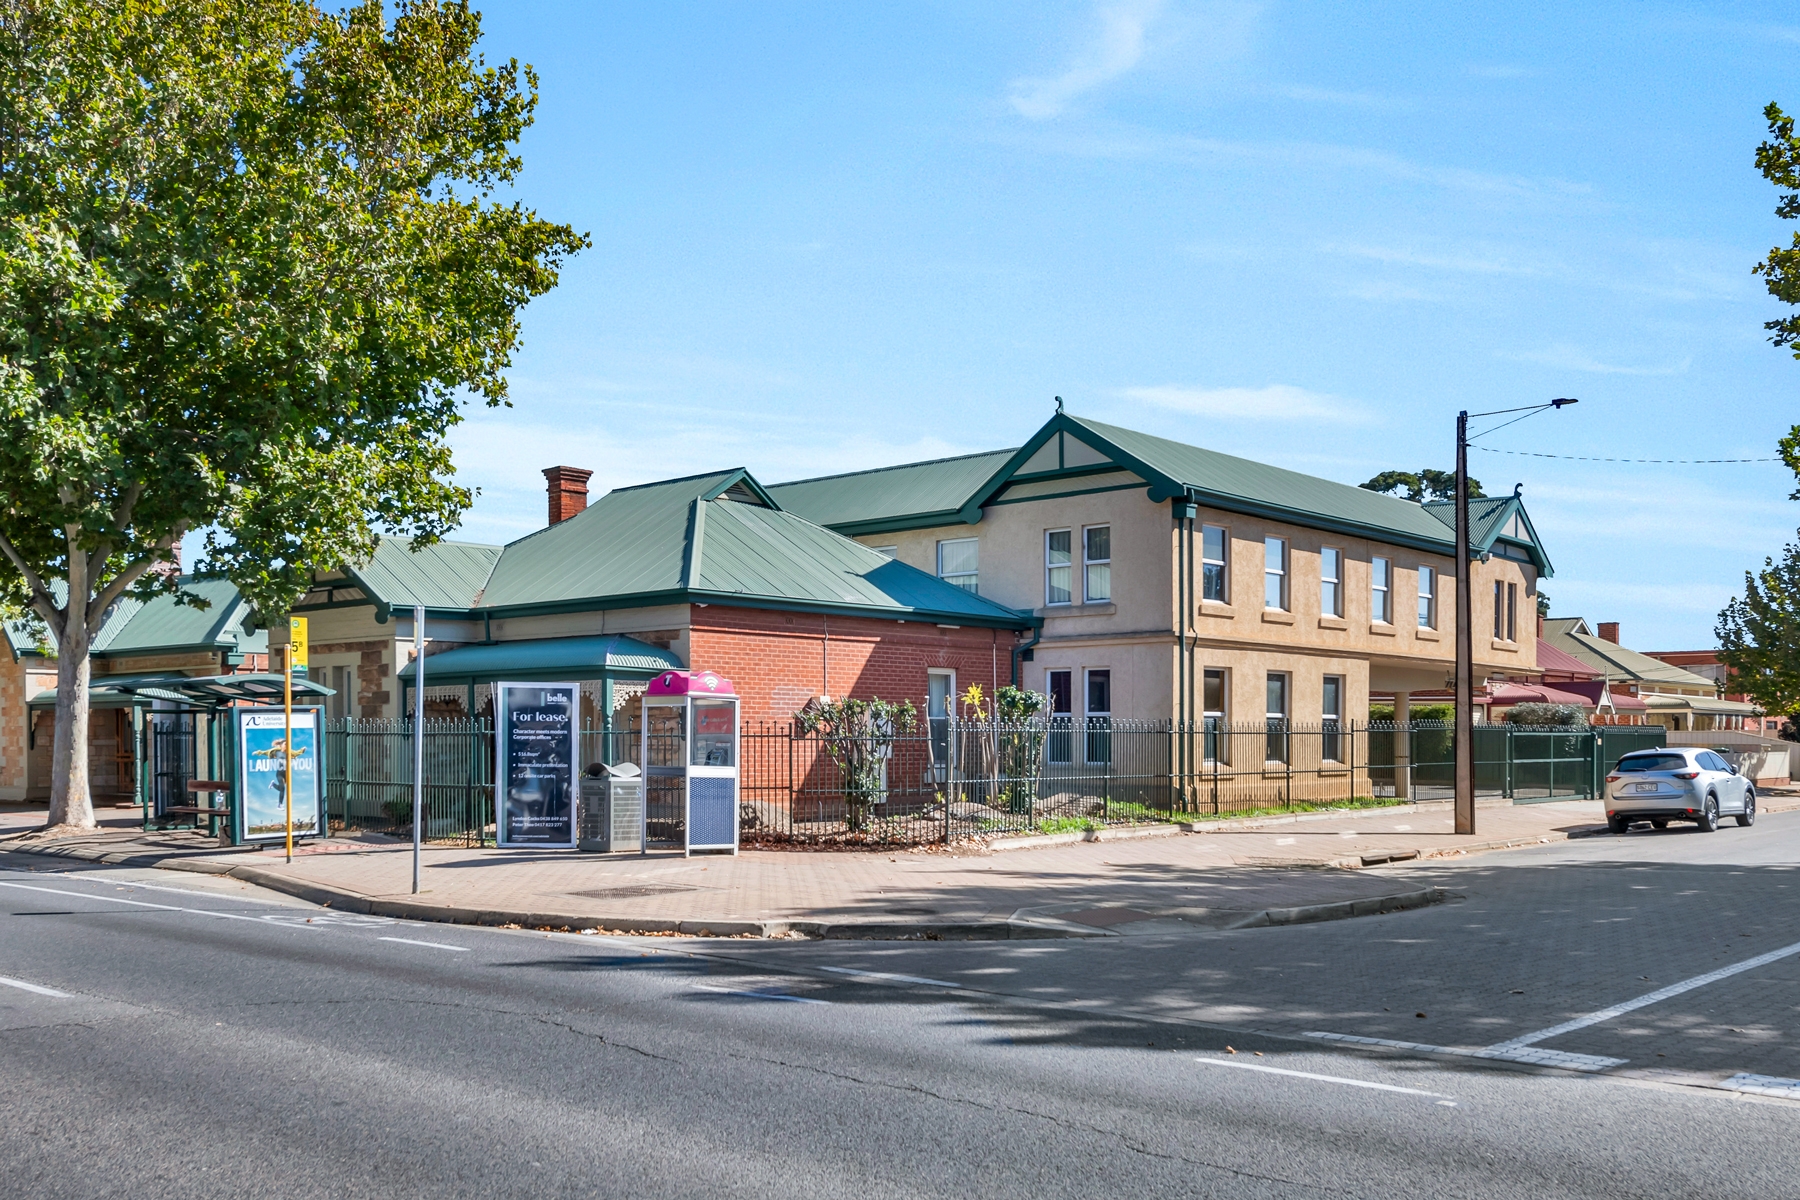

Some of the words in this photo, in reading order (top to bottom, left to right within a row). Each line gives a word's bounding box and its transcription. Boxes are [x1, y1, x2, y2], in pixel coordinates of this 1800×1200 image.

[547, 693, 568, 702] belle
[513, 711, 534, 721] For
[536, 711, 569, 721] lease.
